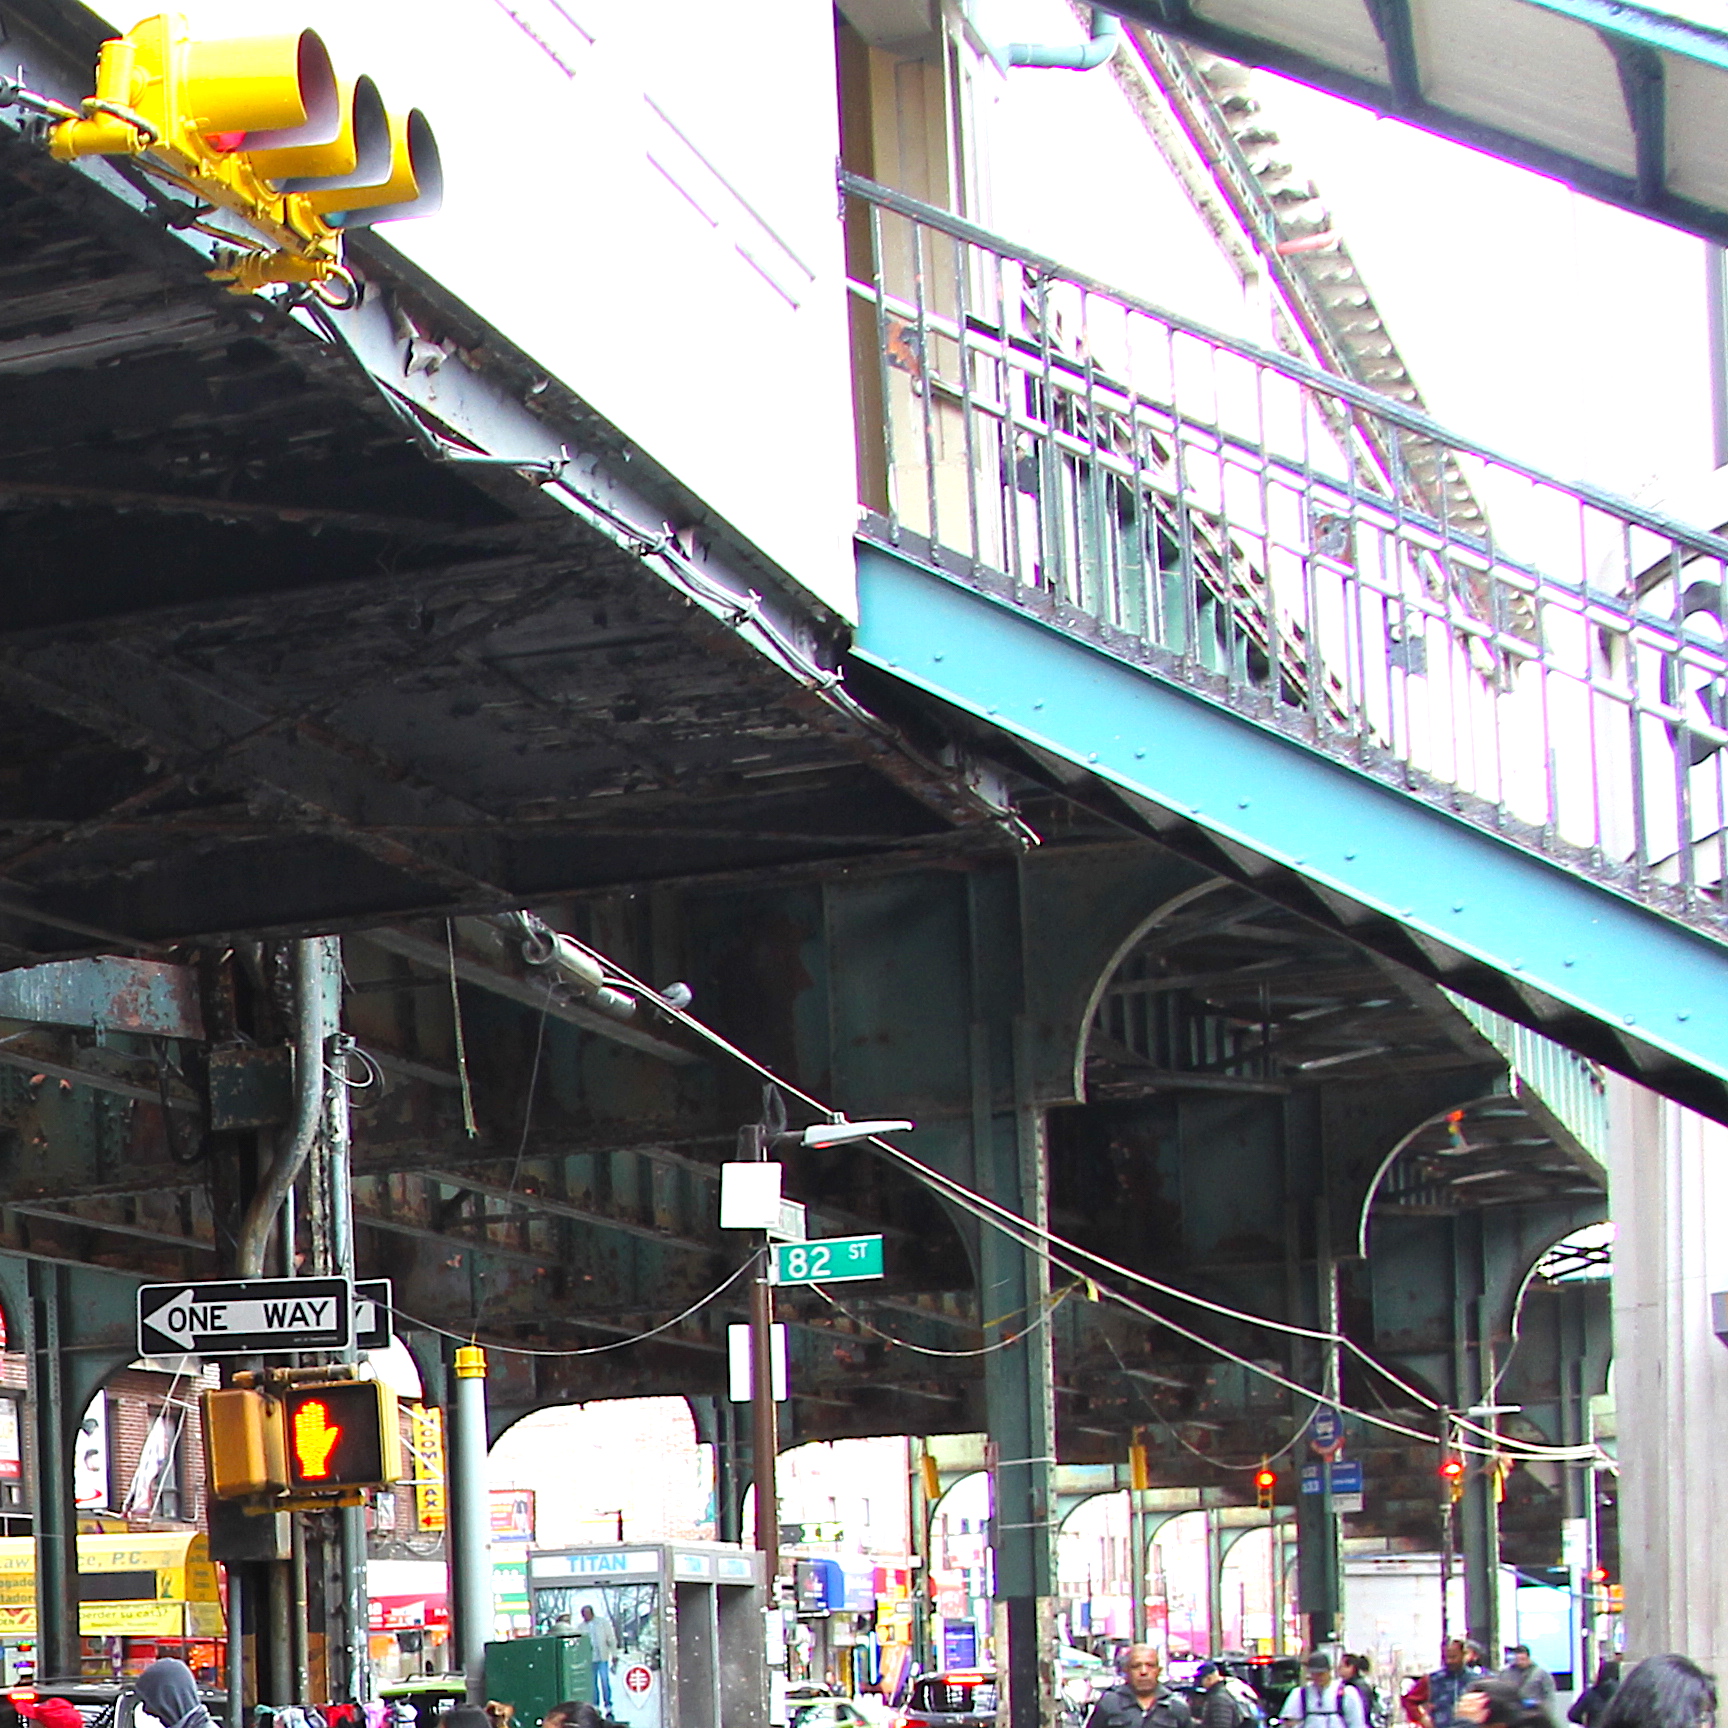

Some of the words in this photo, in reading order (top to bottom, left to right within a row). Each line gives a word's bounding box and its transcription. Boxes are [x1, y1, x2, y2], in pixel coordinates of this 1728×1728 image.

[787, 1245, 832, 1279] 82
[847, 1242, 869, 1260] ST
[167, 1305, 228, 1333] ONE
[263, 1300, 329, 1329] WAY
[566, 1554, 626, 1573] TITAN
